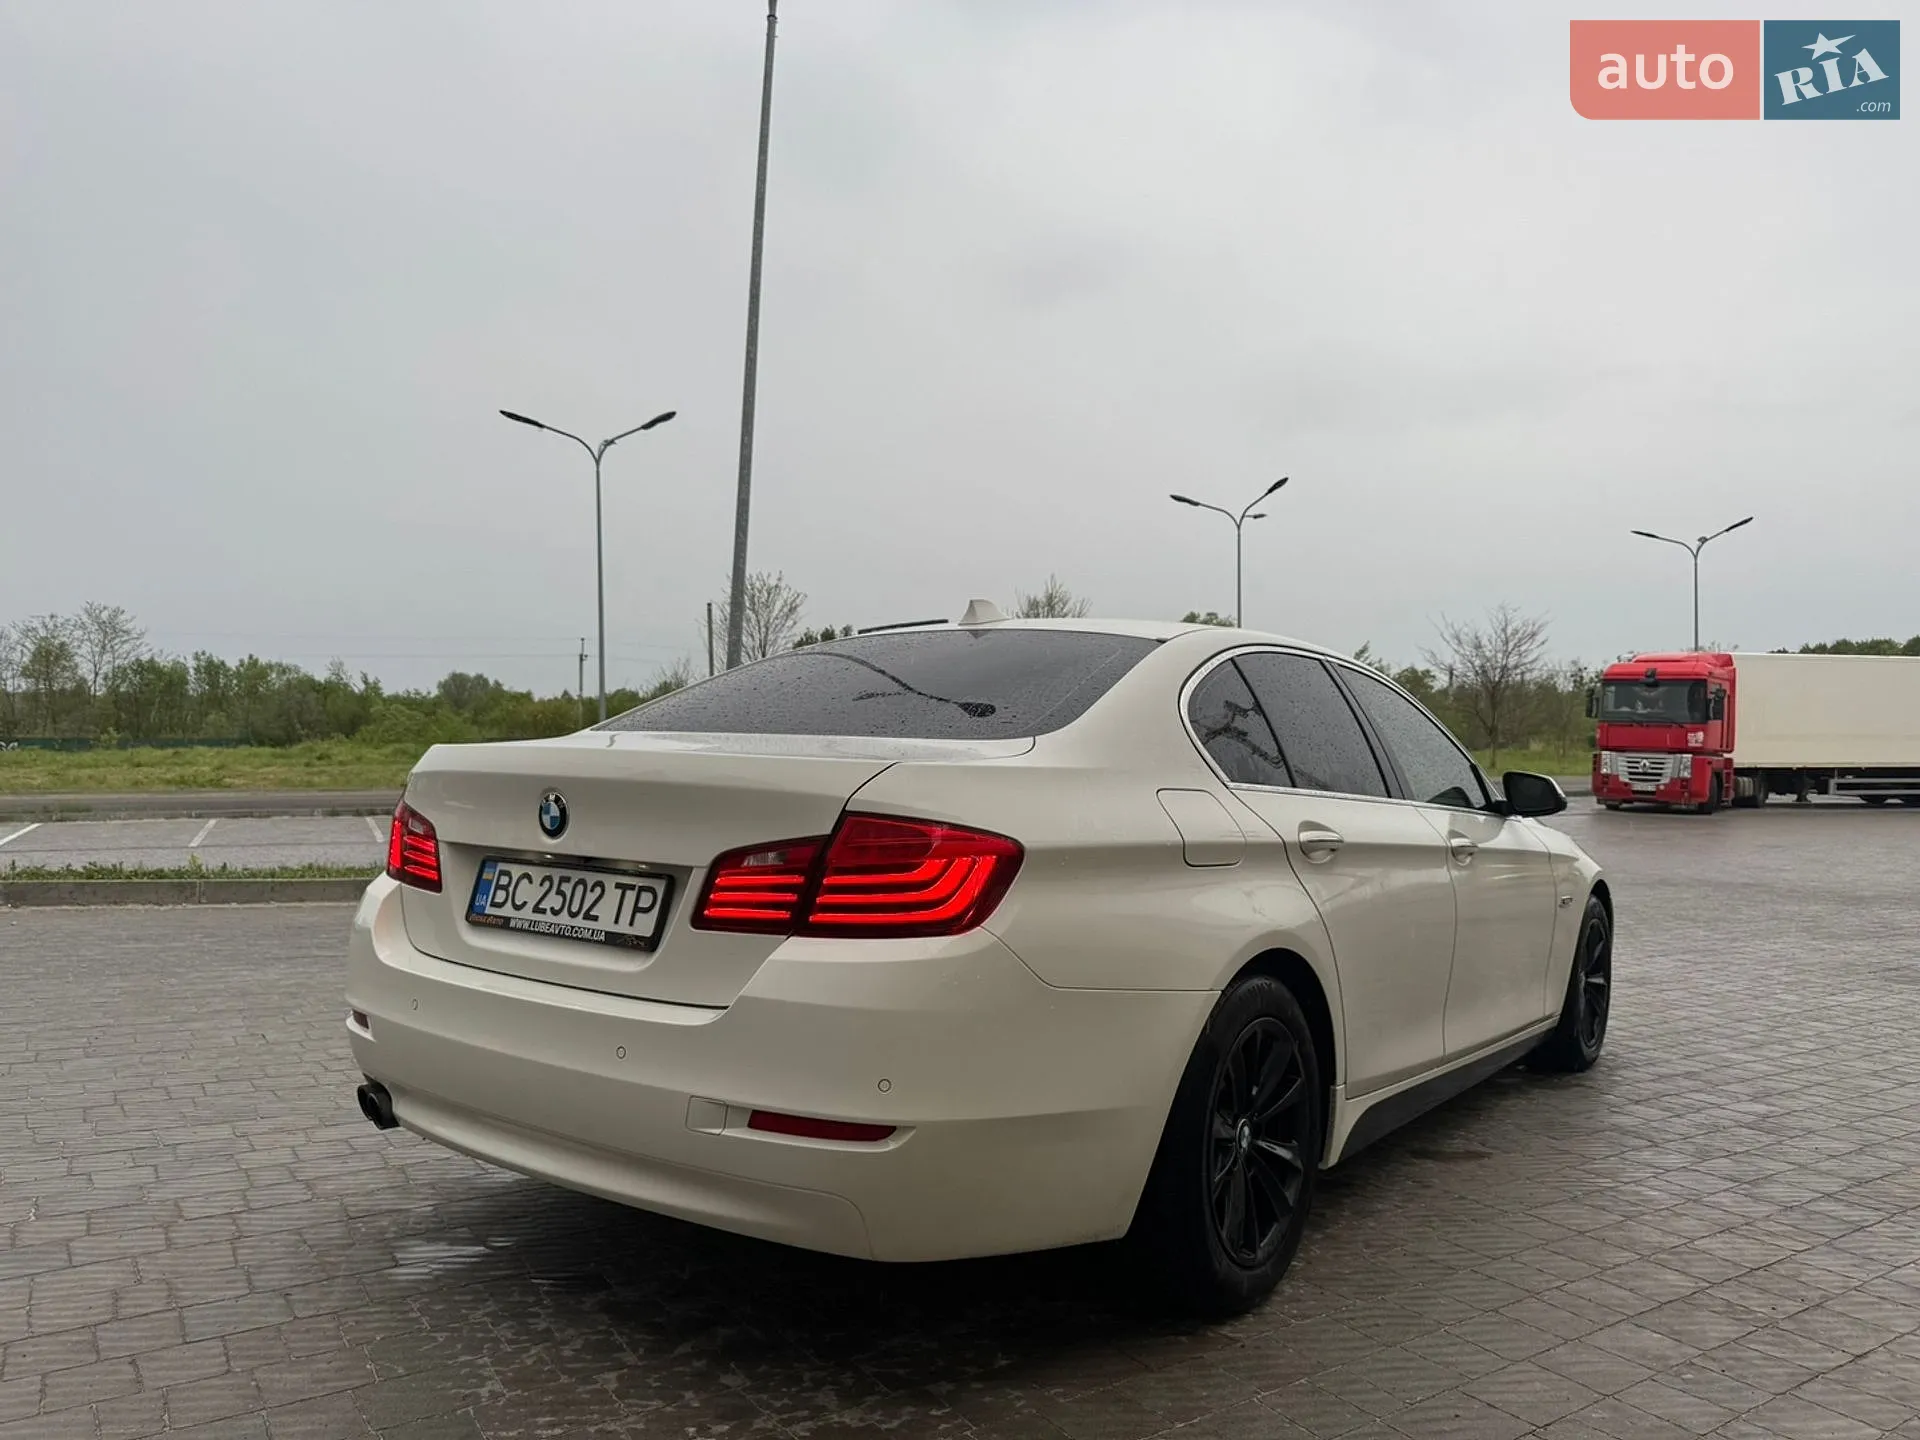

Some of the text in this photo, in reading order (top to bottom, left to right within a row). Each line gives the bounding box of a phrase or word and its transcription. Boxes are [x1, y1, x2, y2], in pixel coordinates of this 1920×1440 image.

[489, 869, 658, 927] BC 2502 TP
